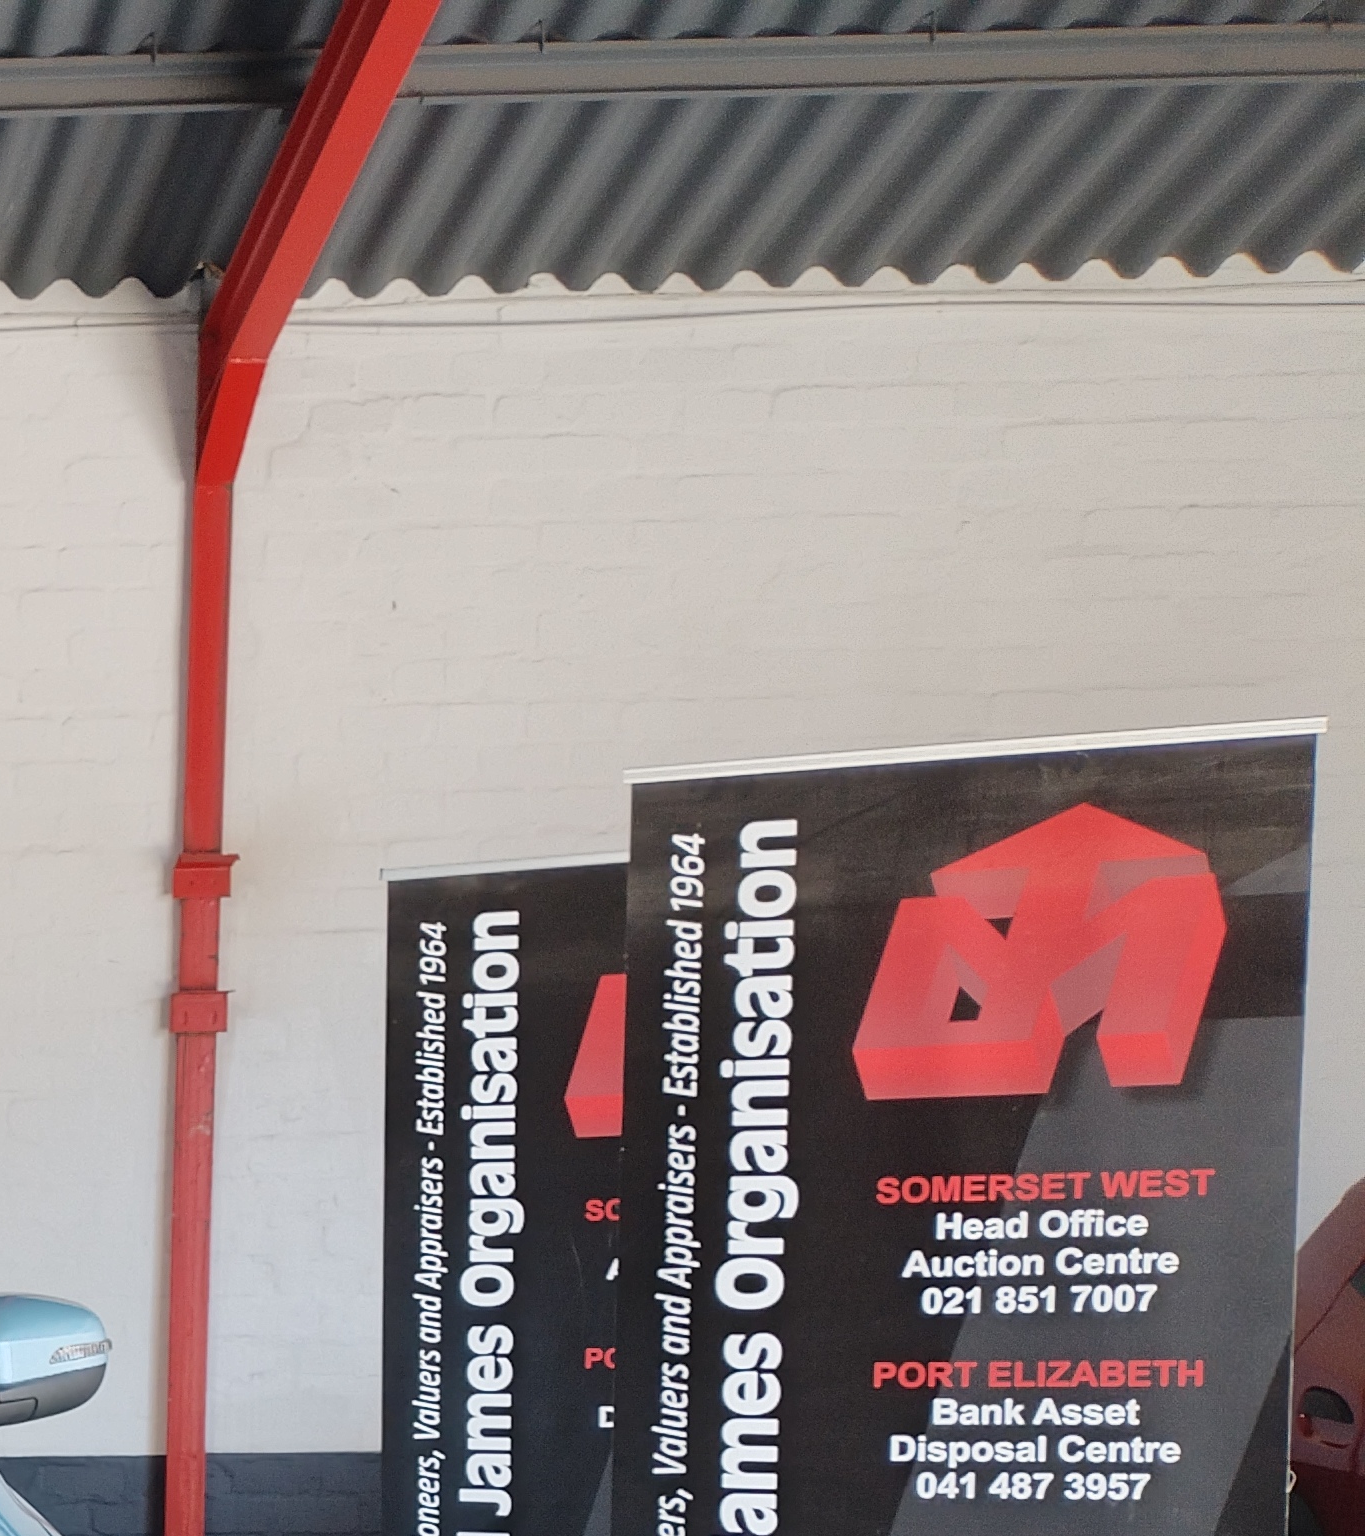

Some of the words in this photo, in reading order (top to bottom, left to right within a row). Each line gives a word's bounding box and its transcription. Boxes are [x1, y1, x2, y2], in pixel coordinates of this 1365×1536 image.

[669, 833, 706, 912] 1964
[419, 921, 447, 985] 1964
[662, 918, 703, 1098] Established
[415, 990, 446, 1136] Established
[715, 818, 800, 1311] Organisation
[459, 910, 525, 1308] Organisation
[656, 1123, 702, 1290] Appraisers
[876, 1171, 1091, 1205] SOMERSET
[1100, 1168, 1216, 1199] WEST
[413, 1156, 449, 1291] Appraisers
[935, 1210, 1029, 1241] Head
[1038, 1208, 1149, 1239] Office
[901, 1248, 1045, 1279] Auction
[1055, 1246, 1180, 1276] Centre
[412, 1293, 442, 1344] and
[654, 1292, 692, 1356] and
[921, 1285, 982, 1315] 021
[994, 1285, 1056, 1315] 851
[1070, 1283, 1158, 1313] 7007
[411, 1349, 442, 1440] Valuers
[873, 1361, 978, 1390] PORT
[988, 1359, 1204, 1388] ELIZABETH
[458, 1324, 514, 1517] James
[650, 1361, 690, 1475] Valuers
[932, 1397, 1026, 1426] Bank
[1031, 1397, 1141, 1426] Asset
[889, 1434, 1048, 1469] Disposal
[1057, 1434, 1182, 1464] Centre
[916, 1471, 976, 1500] 041
[988, 1471, 1055, 1500] 487
[1063, 1472, 1152, 1501] 3957
